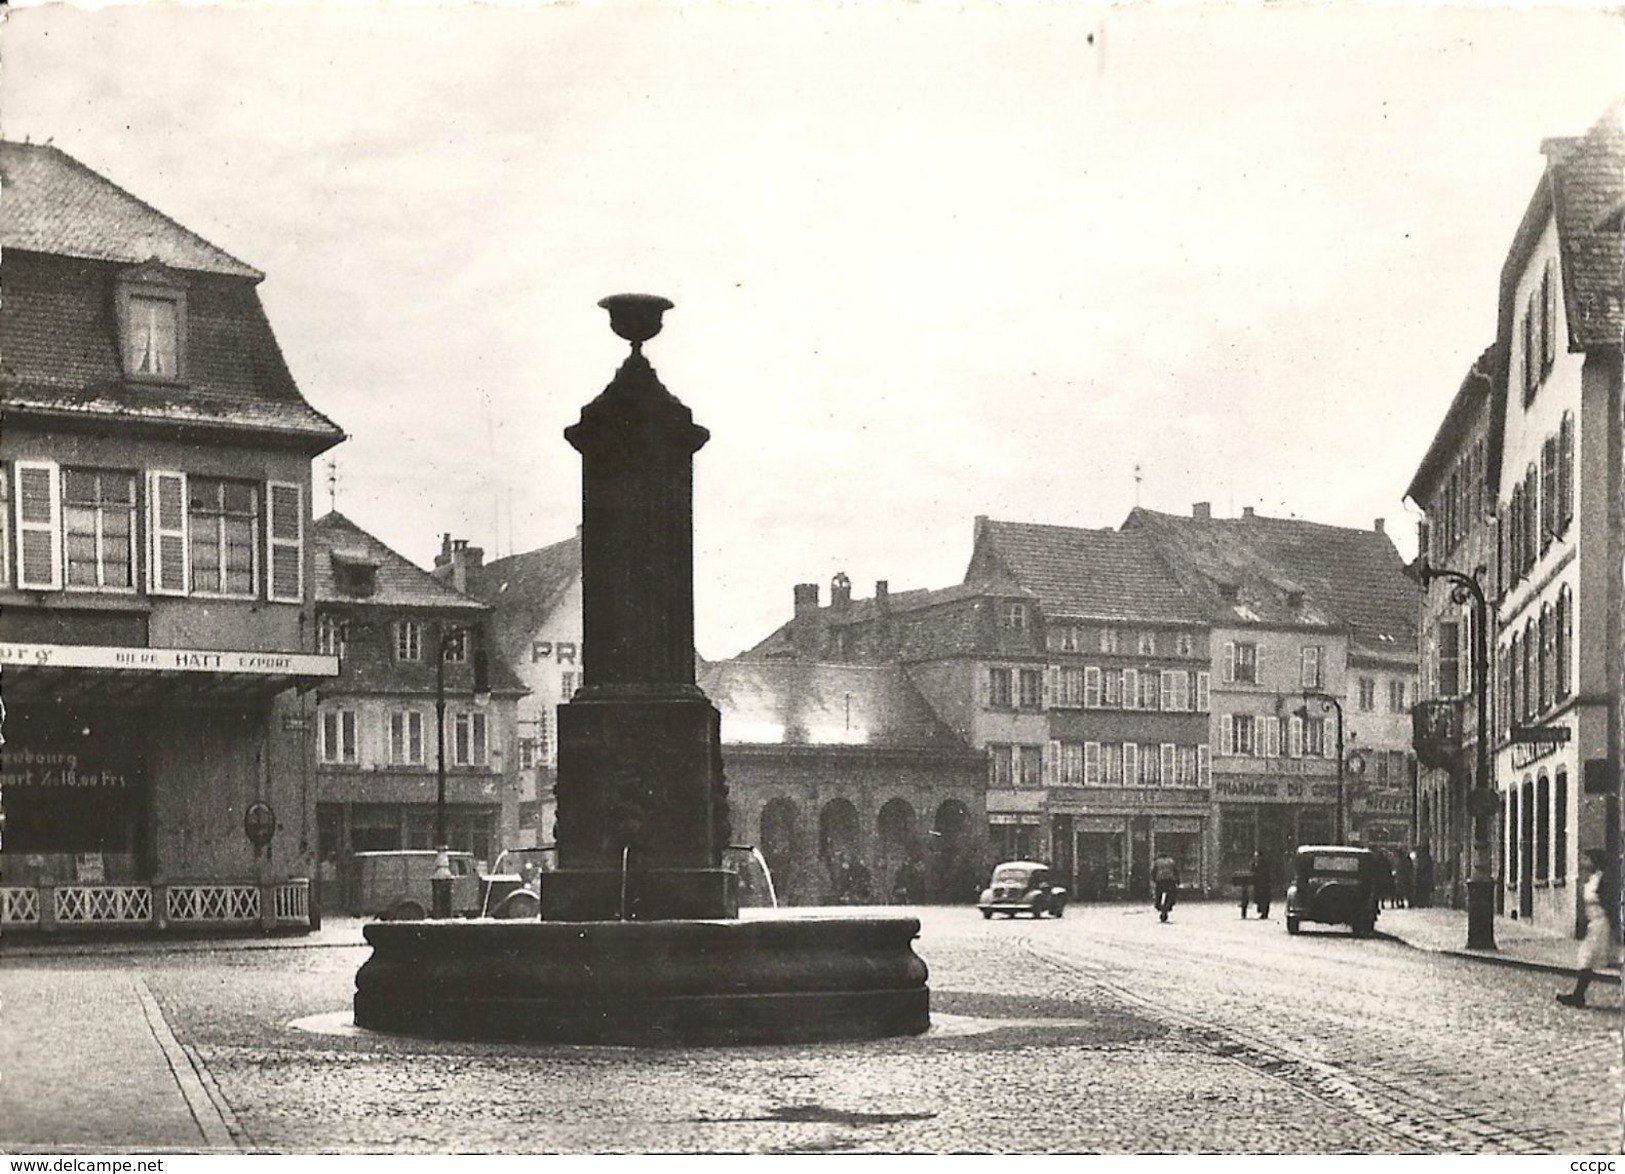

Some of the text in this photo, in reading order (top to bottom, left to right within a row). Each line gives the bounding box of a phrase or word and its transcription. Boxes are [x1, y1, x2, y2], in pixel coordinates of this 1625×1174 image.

[532, 642, 583, 665] PR
[176, 654, 220, 668] HATT
[238, 656, 291, 669] EXPORT
[1216, 782, 1277, 797] PHARMACIE
[1286, 783, 1302, 797] DU
